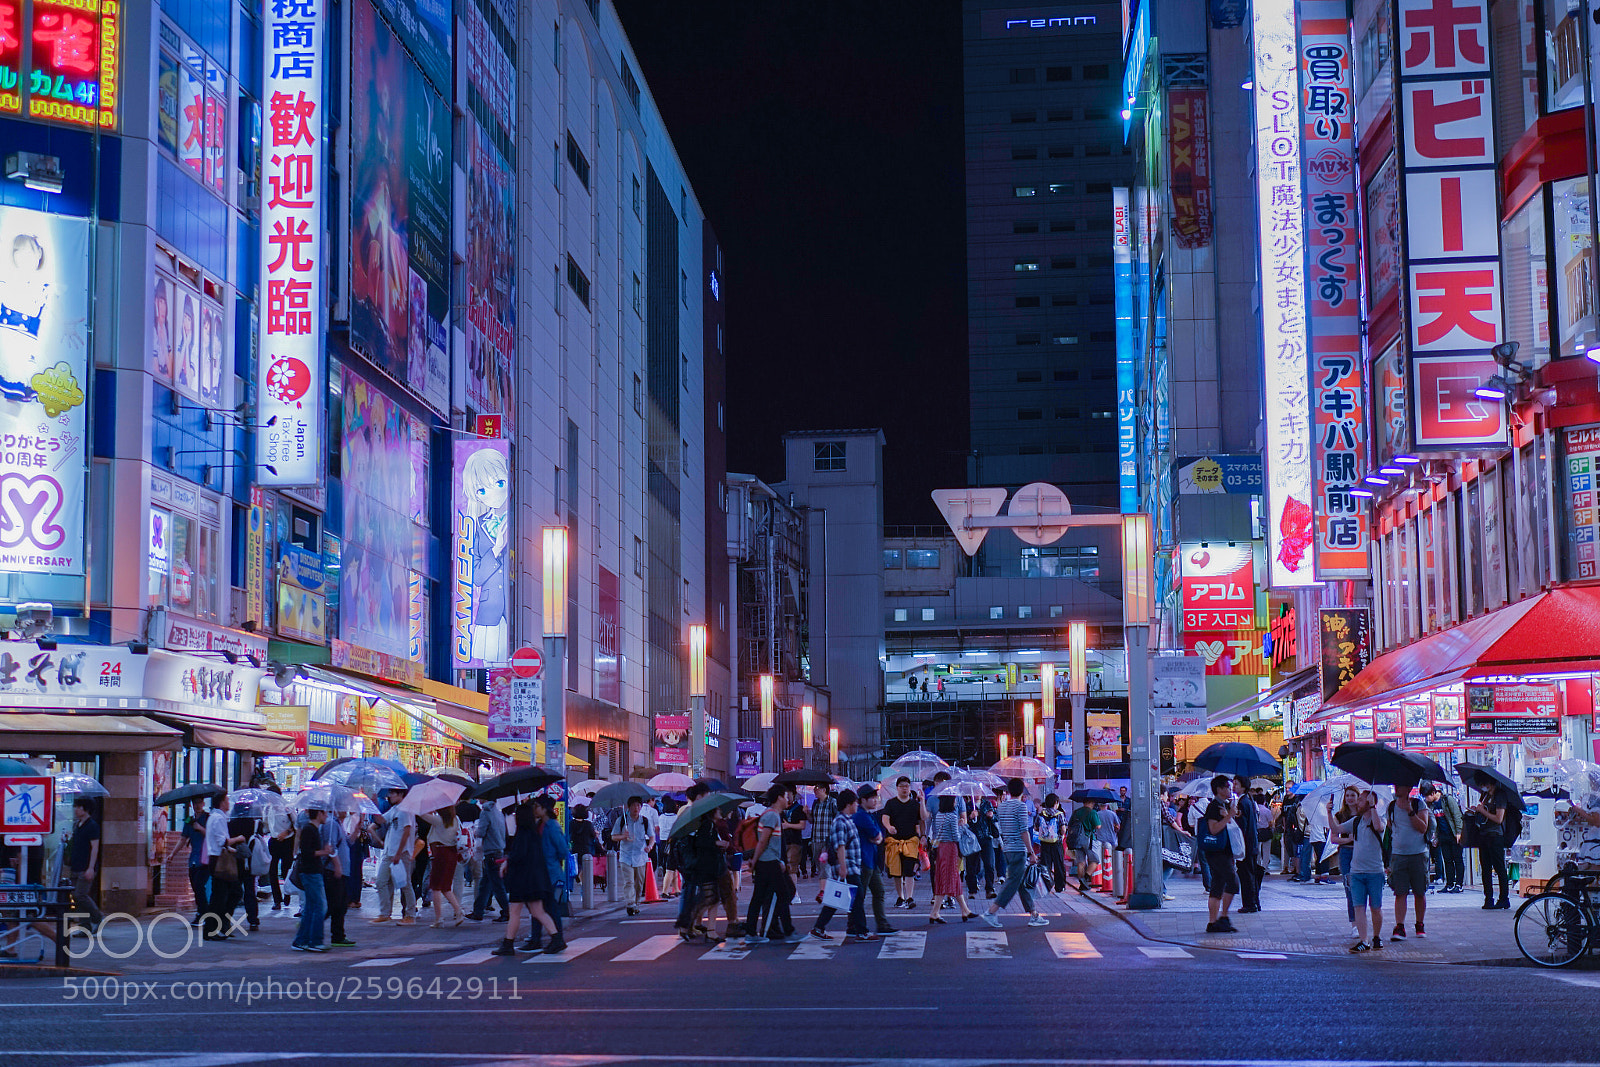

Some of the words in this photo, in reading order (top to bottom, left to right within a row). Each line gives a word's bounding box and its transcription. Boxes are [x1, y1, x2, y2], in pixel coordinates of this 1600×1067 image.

[1006, 16, 1096, 29] remm
[1305, 45, 1345, 141] 買取り
[1173, 97, 1191, 168] TAX
[1271, 90, 1293, 180] SLOT
[267, 90, 317, 336] 歓迎光臨
[1115, 206, 1124, 233] LABI
[1313, 193, 1347, 307] まっくす
[1271, 184, 1303, 360] 魔法少女まどか
[1119, 389, 1137, 476] パソコン館
[1278, 385, 1307, 462] マギカ
[0, 434, 60, 452] りがとう
[266, 433, 280, 462] Shop
[281, 415, 293, 462] Tax-free
[1322, 359, 1358, 546] アキバ駅前店
[1570, 458, 1588, 474] 6F
[1227, 475, 1262, 485] 03-55
[1571, 475, 1589, 490] 5F
[1573, 492, 1591, 506] 4F
[1574, 510, 1592, 525] 3F
[1576, 527, 1593, 543] 2F
[0, 554, 73, 567] NNIVERSARY
[299, 551, 321, 570] DISCOUNT
[1578, 544, 1592, 559] 1F
[298, 564, 324, 583] COMPUTERS
[1580, 562, 1594, 576] B1
[455, 511, 475, 664] GAMERS
[1190, 583, 1245, 601] アコム
[1187, 613, 1208, 627] 3F
[1211, 613, 1238, 627] 入口
[100, 662, 122, 675] 24
[99, 676, 121, 687] 時間
[1536, 705, 1556, 716] 3F
